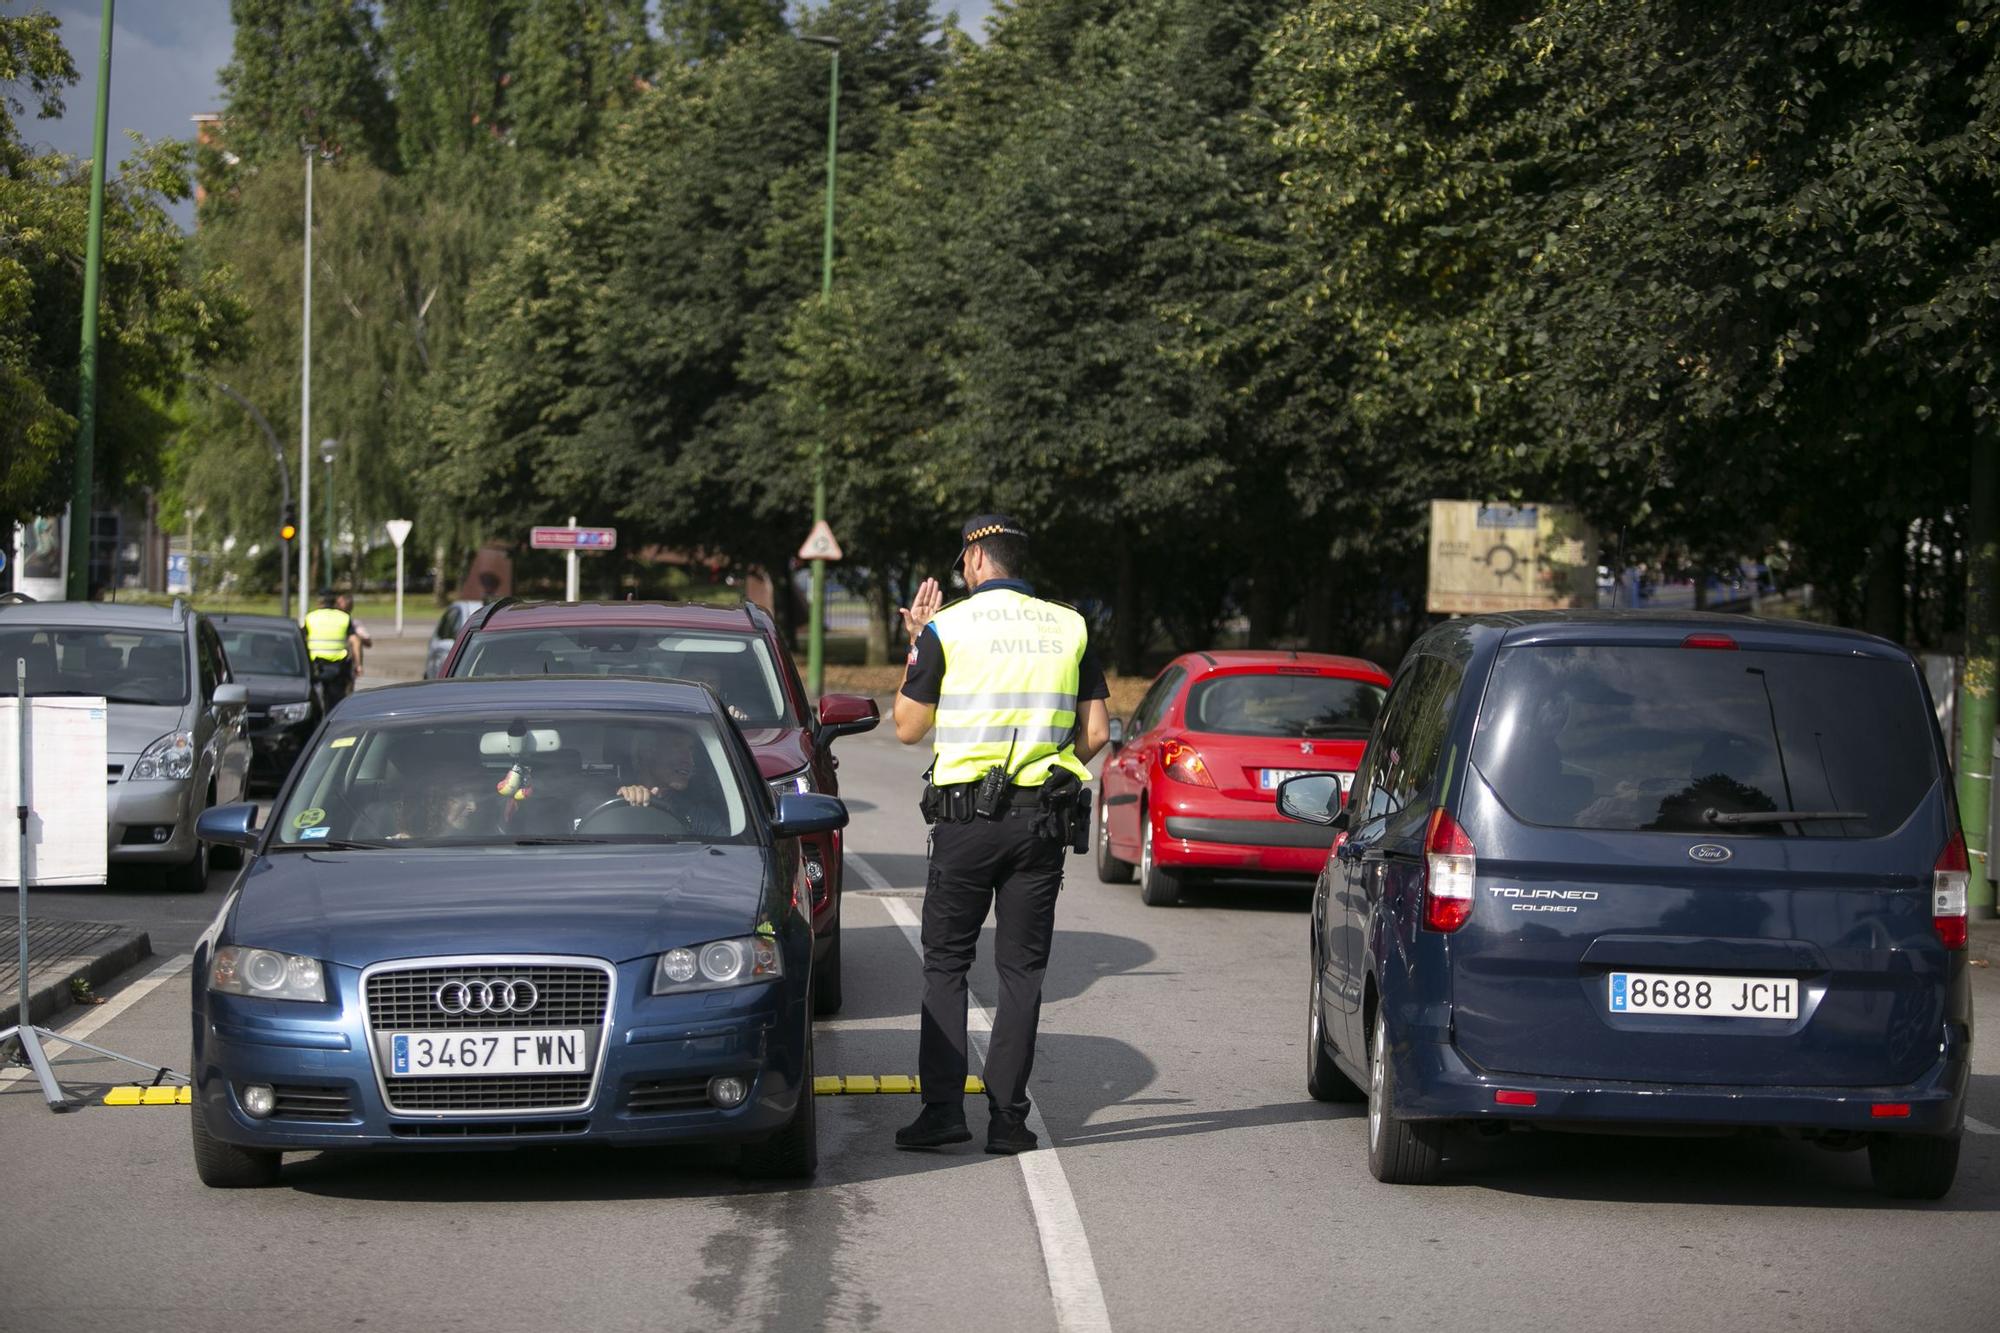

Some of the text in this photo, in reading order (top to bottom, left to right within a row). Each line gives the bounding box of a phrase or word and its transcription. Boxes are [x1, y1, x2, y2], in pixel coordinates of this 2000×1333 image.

[1698, 847, 1721, 859] Ford
[1489, 887, 1599, 901] TOURNEO
[1512, 904, 1578, 913] COURIER
[1615, 979, 1790, 1013] E 8688 JCH
[397, 1035, 575, 1067] E 3467 FWN
